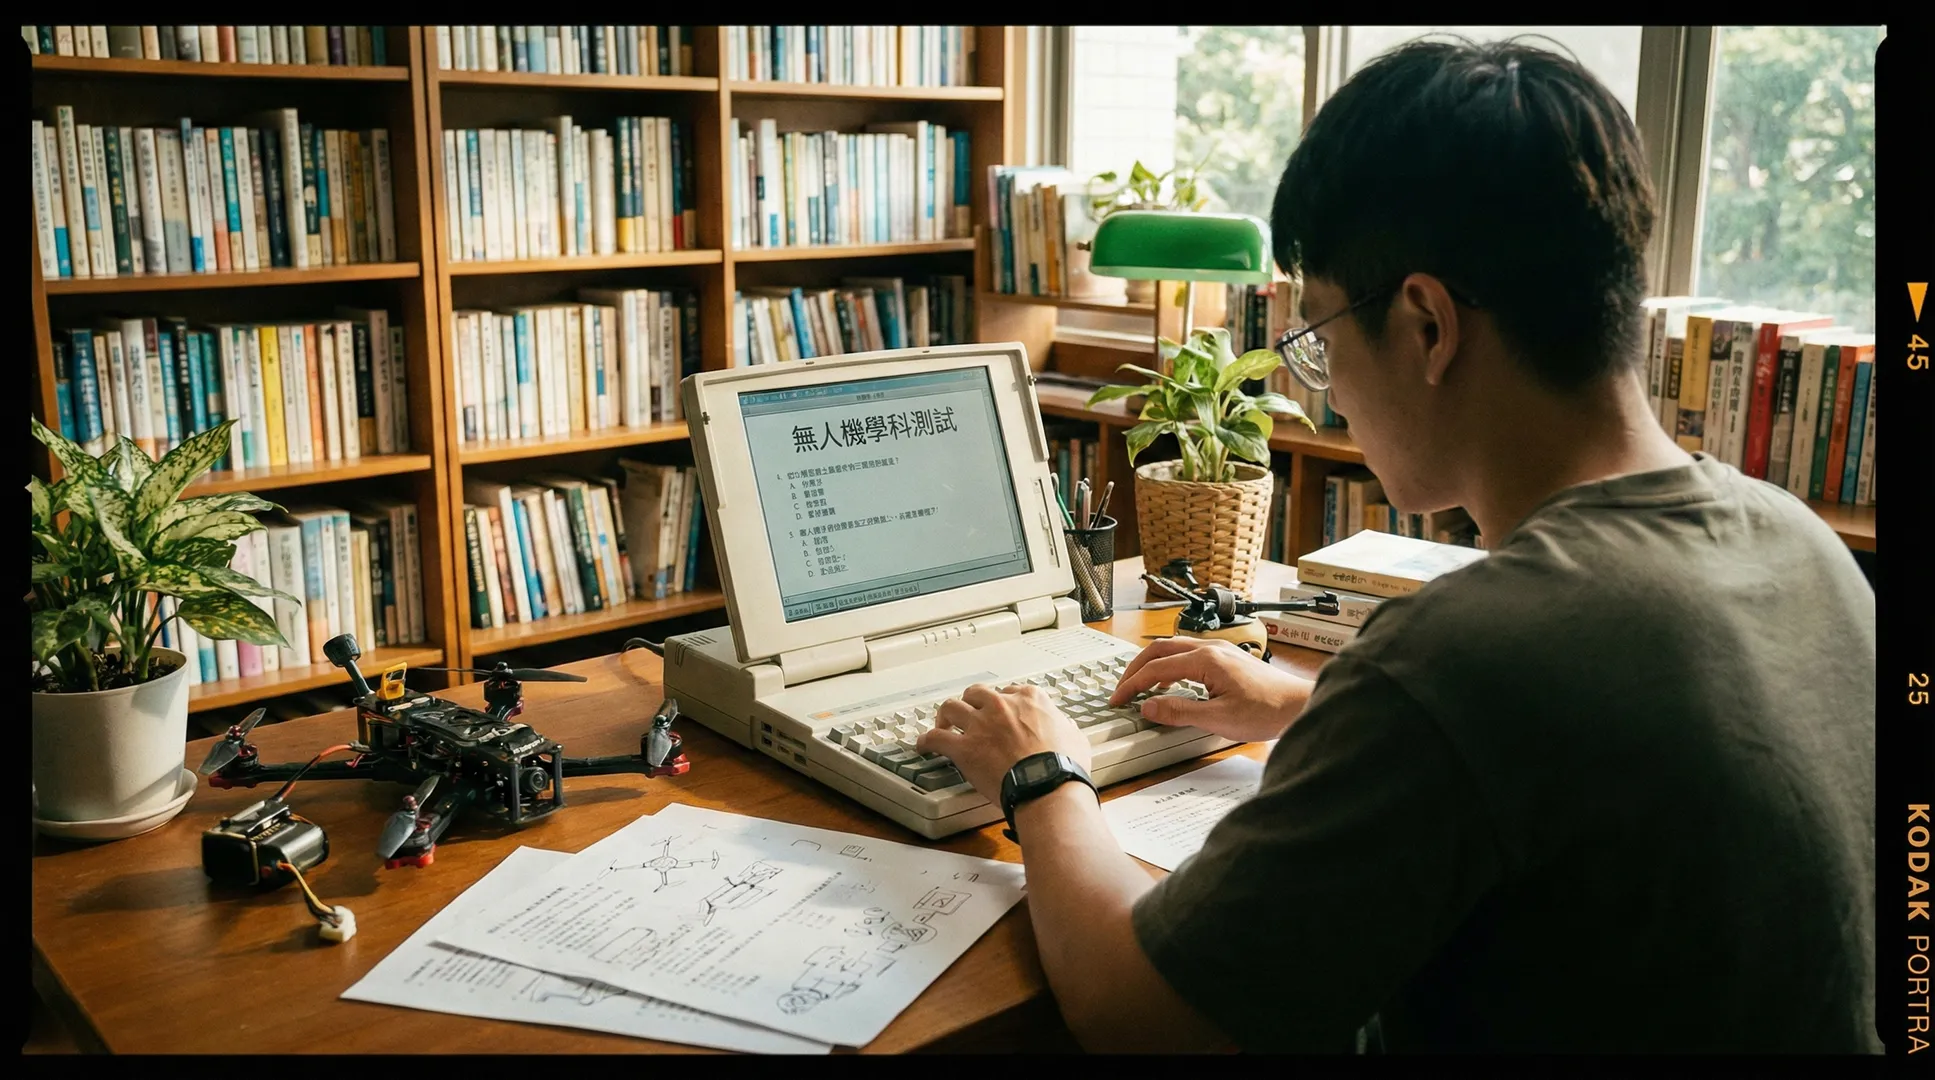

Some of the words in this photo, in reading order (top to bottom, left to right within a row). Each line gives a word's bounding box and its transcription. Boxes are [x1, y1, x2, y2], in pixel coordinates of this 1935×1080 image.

[792, 406, 958, 453] 無人機學科測試
